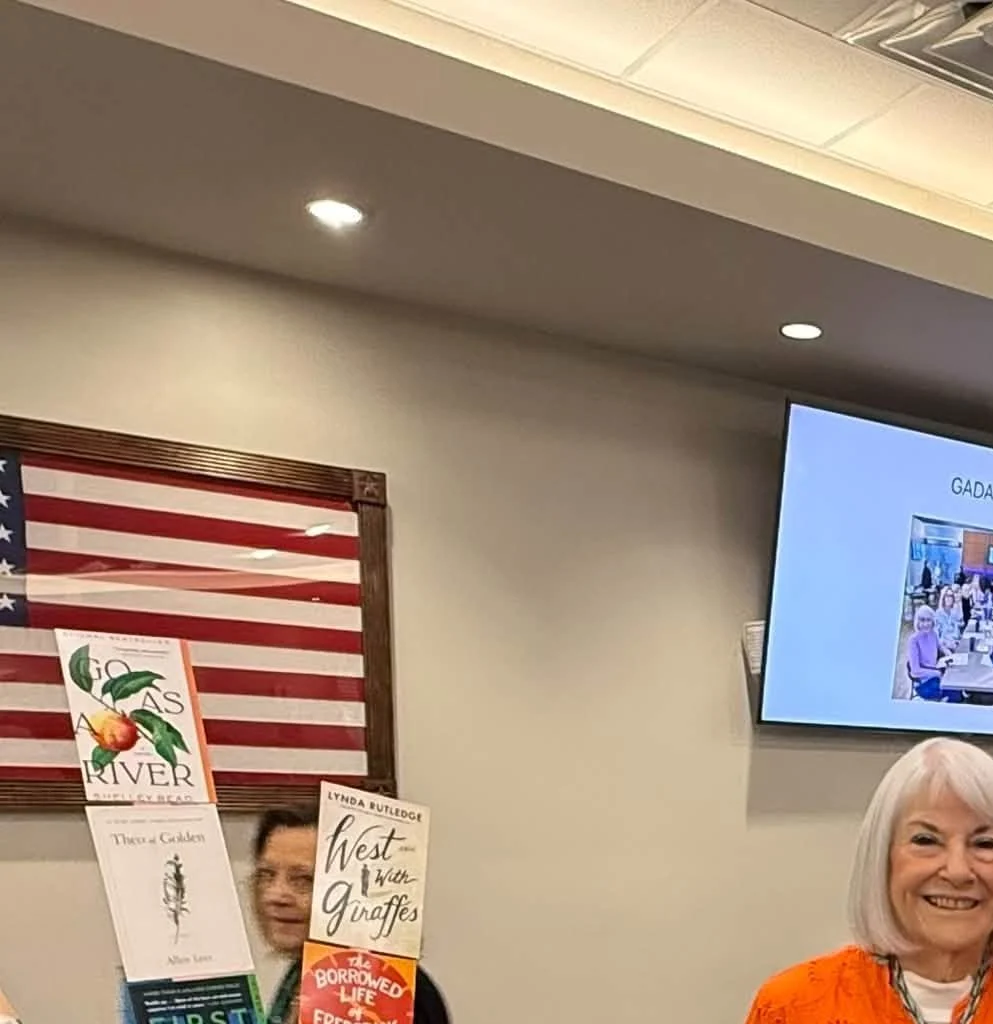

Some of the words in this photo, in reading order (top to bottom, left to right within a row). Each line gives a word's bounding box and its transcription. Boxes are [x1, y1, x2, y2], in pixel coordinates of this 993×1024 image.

[141, 690, 185, 715] AS
[75, 711, 99, 736] A
[83, 759, 194, 787] RIVER
[328, 791, 366, 808] LYNDA
[369, 802, 423, 822] RUTLEDGE
[111, 832, 145, 846] Theo
[160, 831, 205, 845] Golden
[325, 814, 407, 873] West
[314, 968, 404, 999] BORROWED
[339, 985, 377, 1006] LIFE
